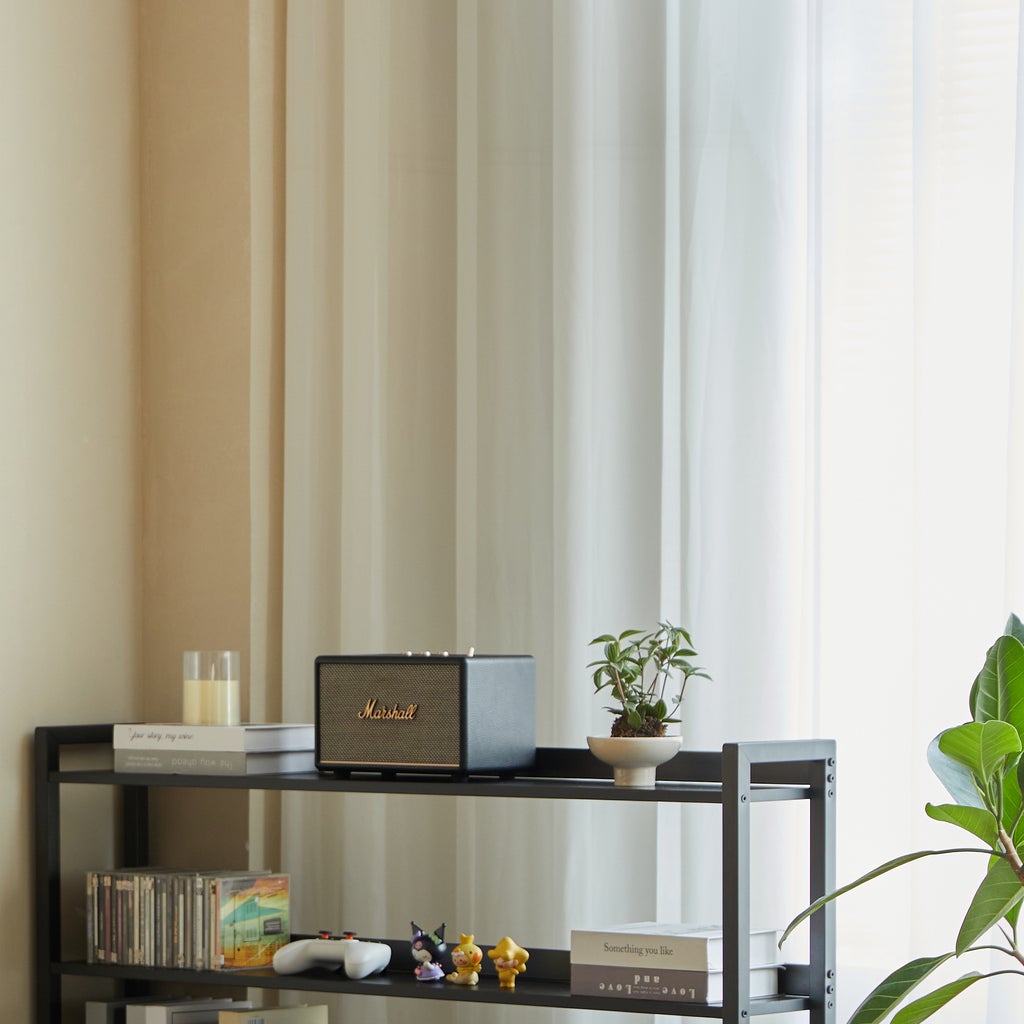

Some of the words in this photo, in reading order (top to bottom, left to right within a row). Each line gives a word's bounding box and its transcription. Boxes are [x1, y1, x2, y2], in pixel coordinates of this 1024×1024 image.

[358, 698, 418, 720] Marshall
[603, 942, 644, 957] Something
[645, 946, 659, 957] you
[660, 945, 674, 956] like
[634, 974, 660, 985] and
[599, 982, 632, 995] Love
[662, 987, 696, 999] Love
